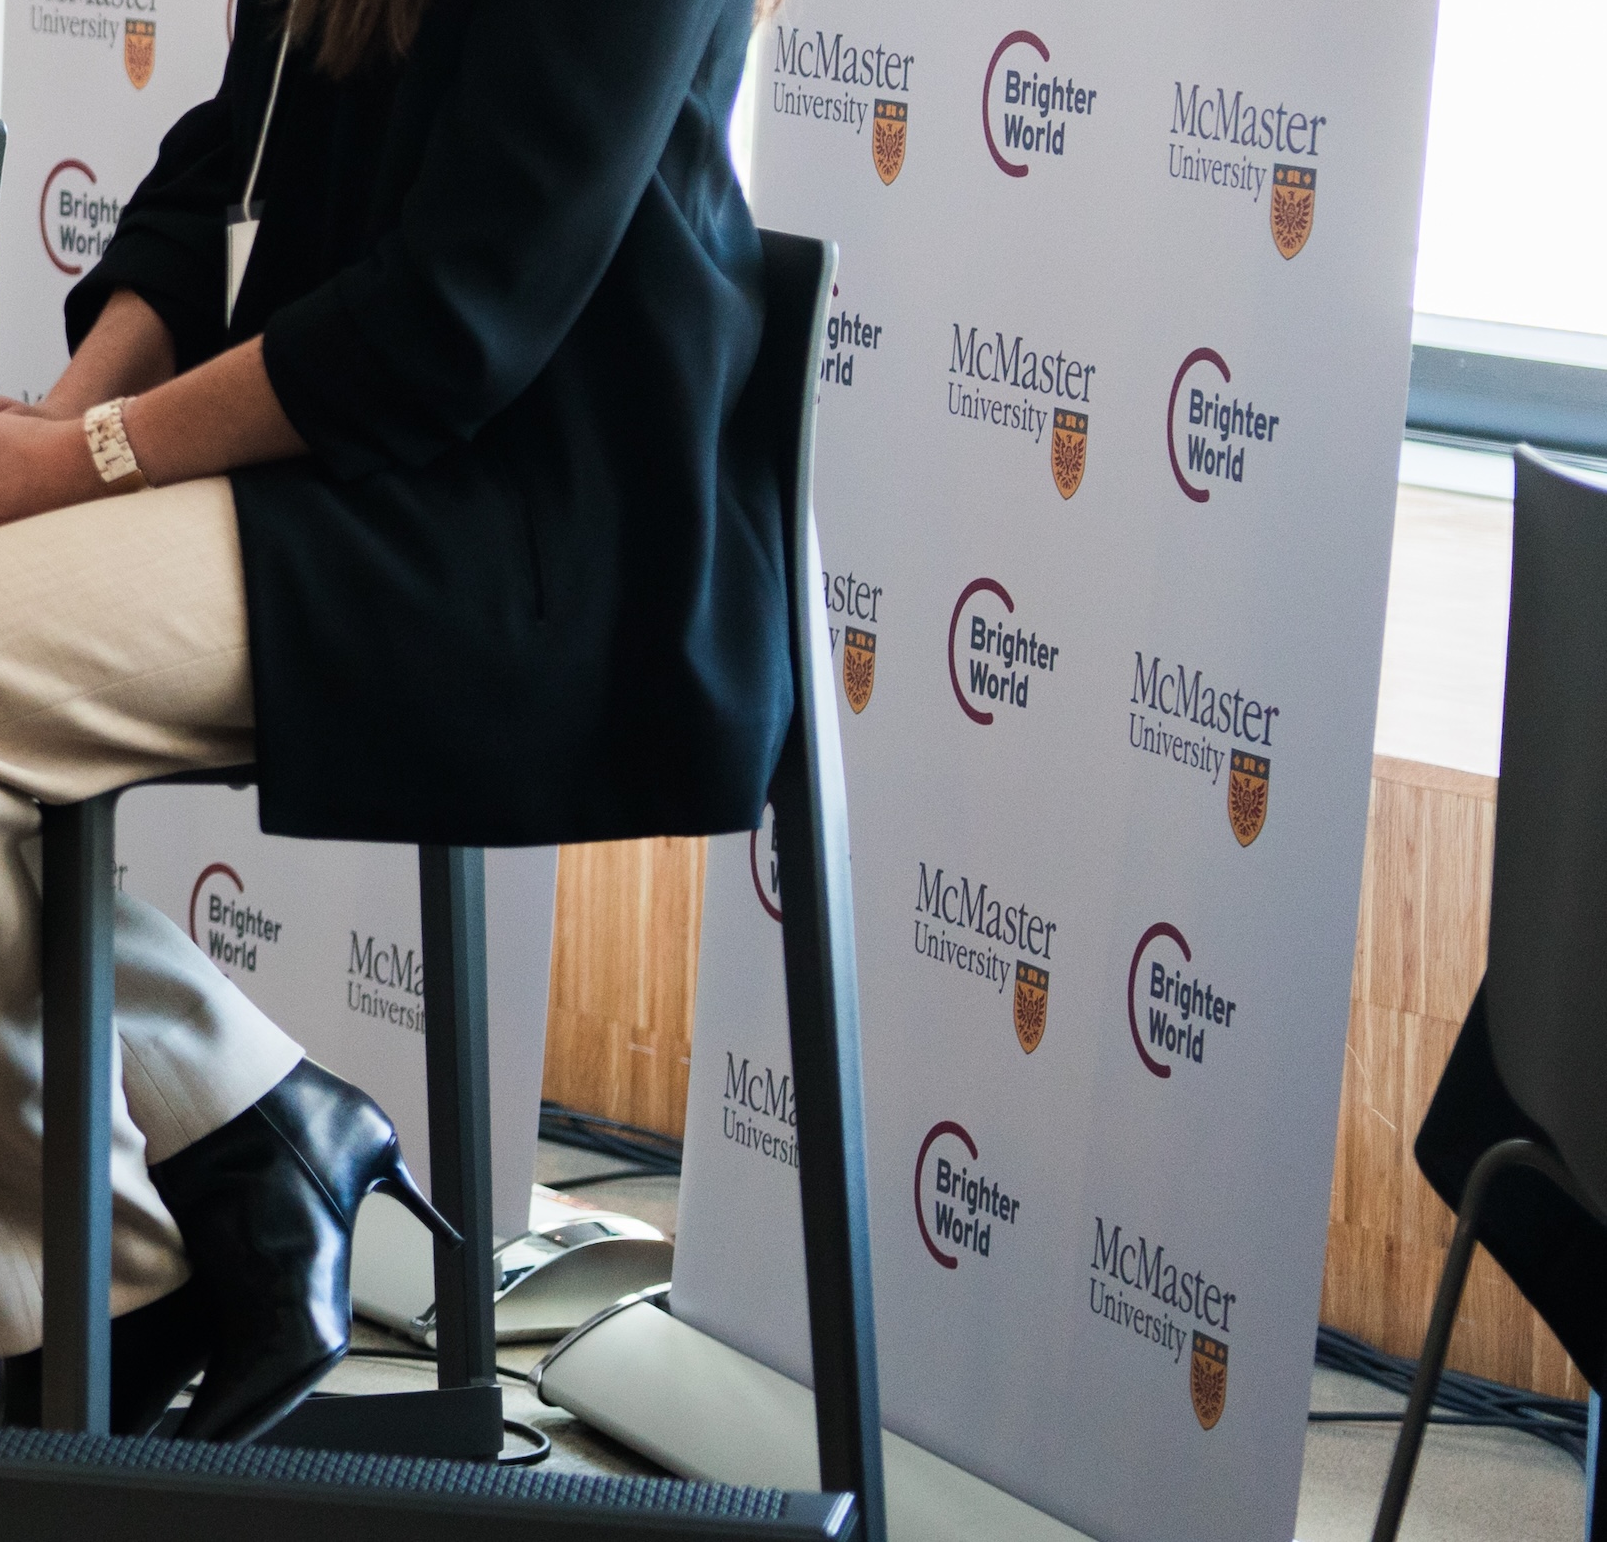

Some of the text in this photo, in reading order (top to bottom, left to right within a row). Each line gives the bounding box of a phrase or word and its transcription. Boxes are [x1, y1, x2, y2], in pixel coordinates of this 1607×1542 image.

[31, 4, 120, 48] University
[774, 25, 915, 92] McMaster
[773, 81, 868, 134] University
[1004, 69, 1097, 117] Brighter
[1170, 81, 1326, 157] McMaster
[1004, 113, 1066, 156] World
[1169, 144, 1267, 203] University
[827, 311, 882, 350] ghter
[949, 323, 1096, 403] McMaster
[947, 382, 1047, 444] University
[1189, 388, 1279, 444] Brighter
[1188, 434, 1244, 483] World
[970, 615, 1059, 673] Brighter
[970, 660, 1029, 709] World
[1131, 651, 1279, 746] McMaster
[1129, 713, 1226, 785] University
[209, 895, 282, 942] Brighter
[915, 862, 1057, 959] McMaster
[209, 930, 257, 972] World
[348, 930, 423, 996] McMa
[914, 920, 1011, 993] University
[1151, 962, 1236, 1029] Brighter
[1150, 1006, 1204, 1063] World
[936, 1158, 1020, 1225] Brighter
[936, 1200, 991, 1257] World
[1091, 1217, 1236, 1333] McMaster
[1090, 1277, 1188, 1364] University
